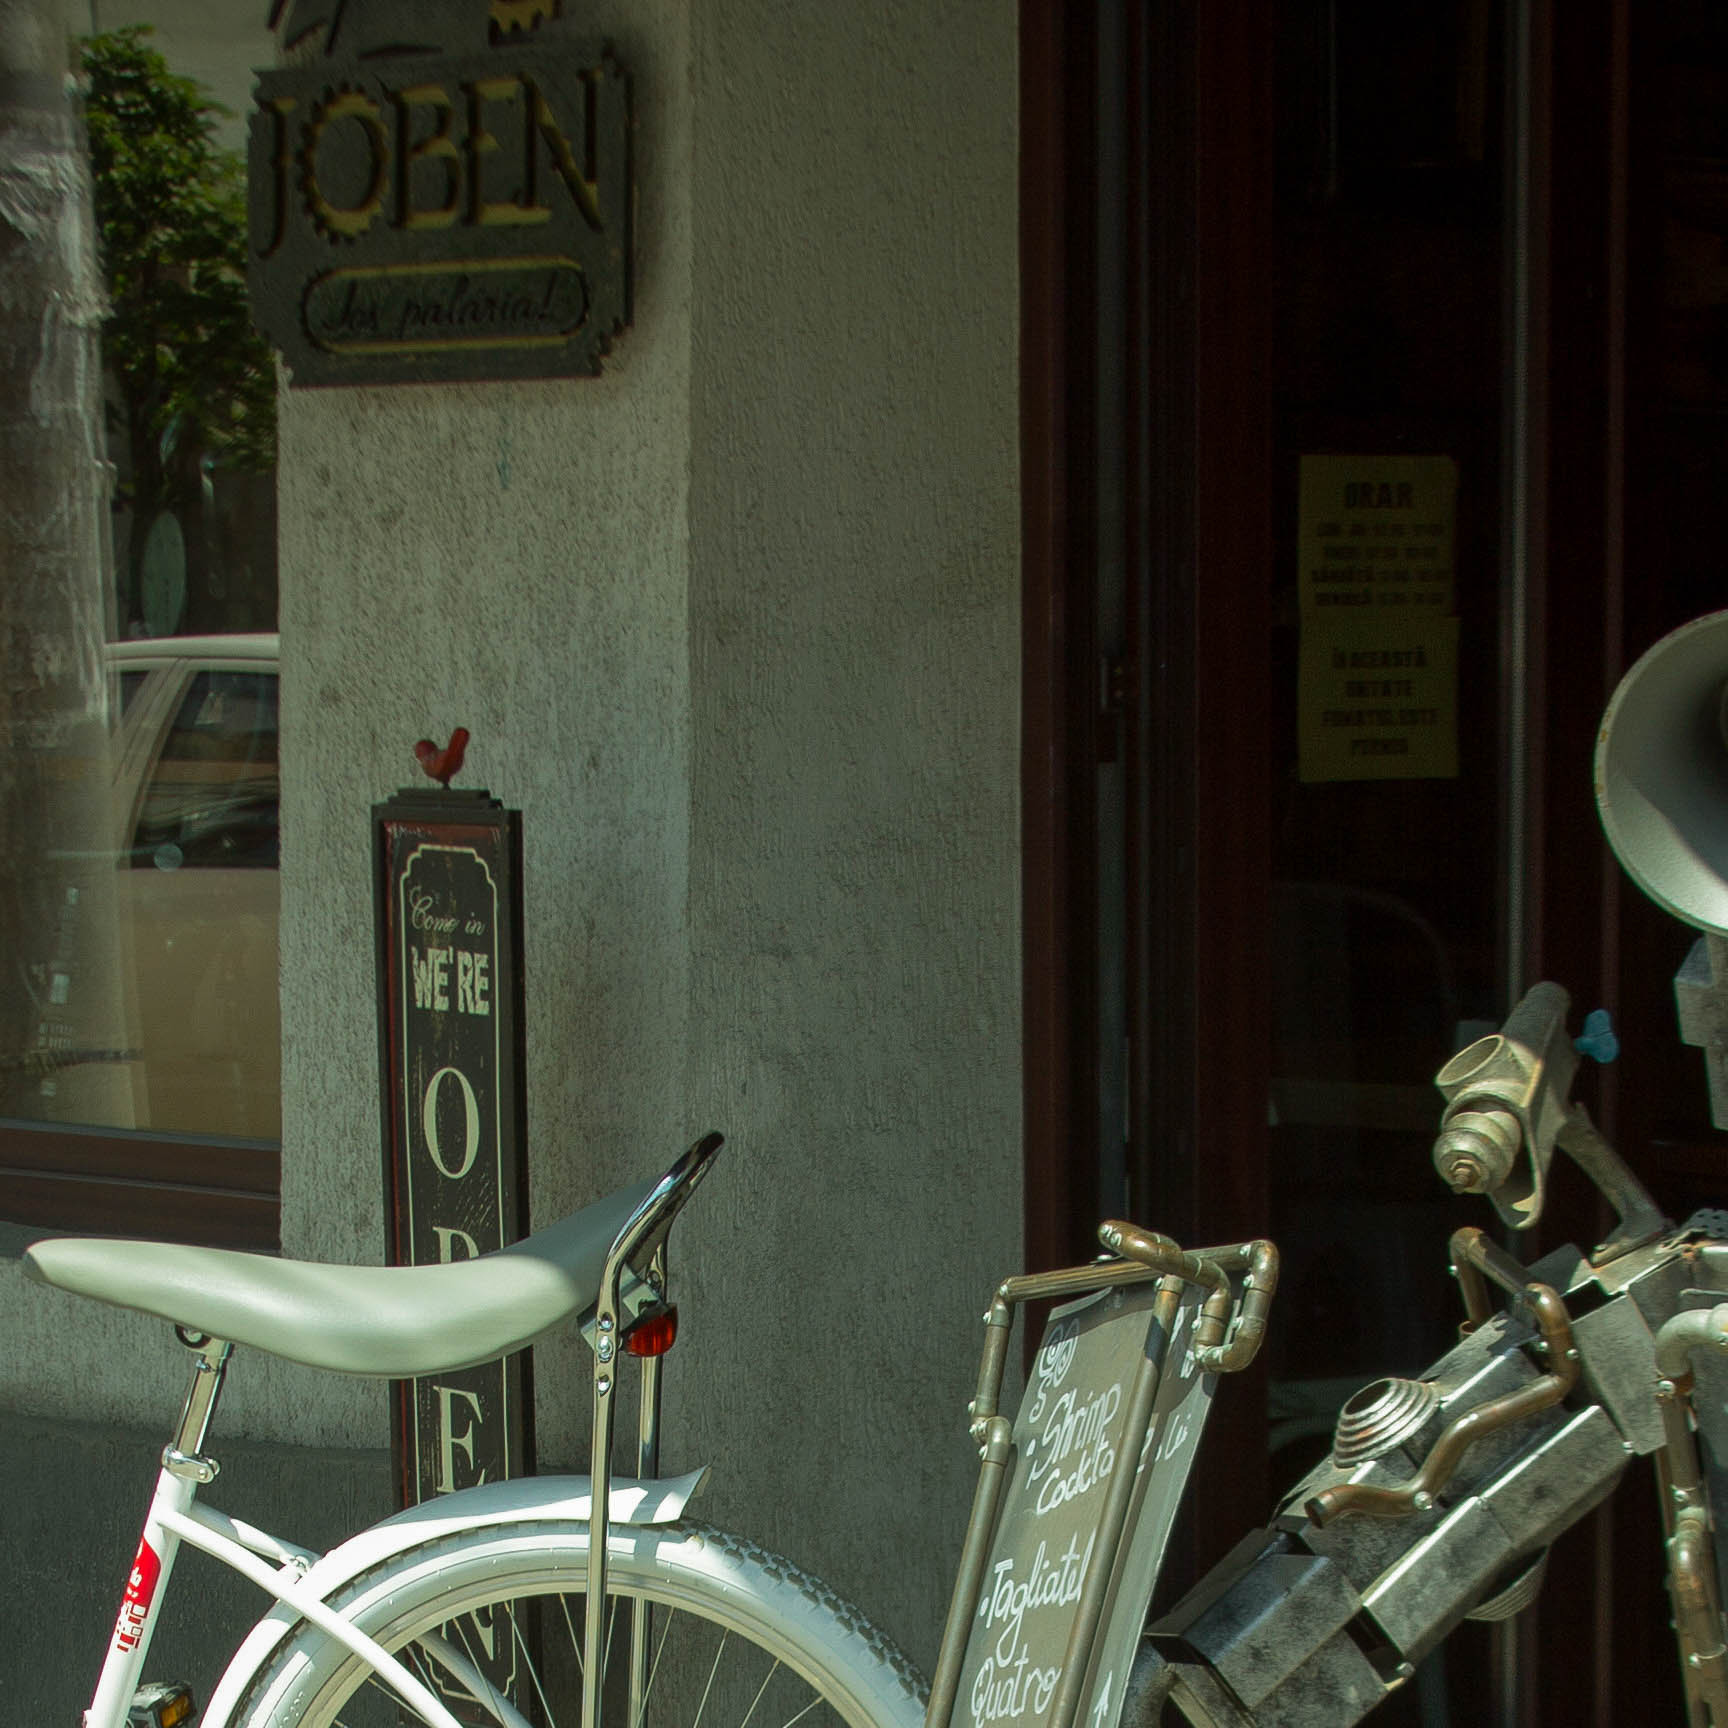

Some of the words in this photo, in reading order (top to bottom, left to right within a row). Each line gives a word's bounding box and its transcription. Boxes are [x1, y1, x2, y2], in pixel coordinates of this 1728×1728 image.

[256, 70, 604, 258] JOBEN
[1344, 482, 1414, 509] ORAR
[409, 884, 459, 931] Come
[464, 911, 487, 936] in
[410, 945, 491, 1016] WE'RE
[1025, 1383, 1122, 1491] Shrimp
[1035, 1433, 1116, 1516] Cockta
[985, 1527, 1097, 1668] Tagliatel
